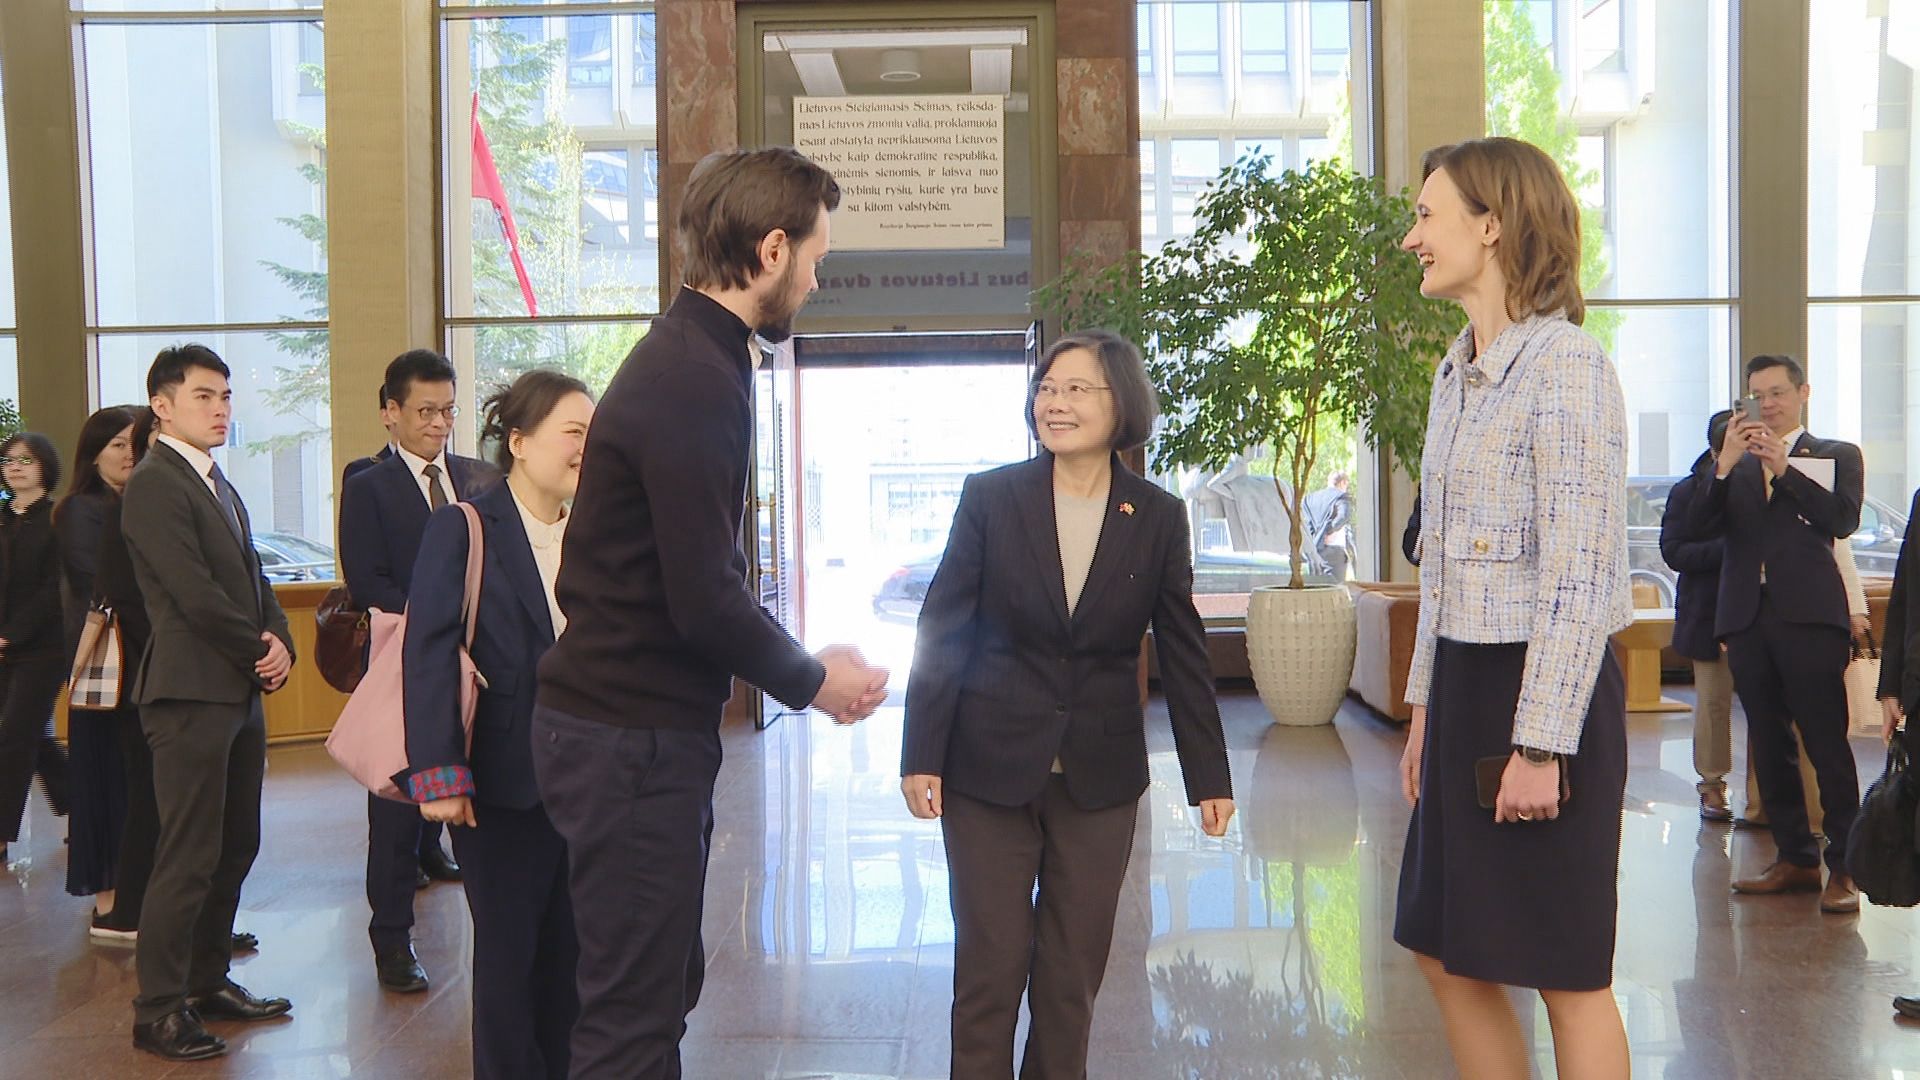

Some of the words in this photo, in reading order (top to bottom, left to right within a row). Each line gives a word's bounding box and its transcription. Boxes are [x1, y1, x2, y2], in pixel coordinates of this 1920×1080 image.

[799, 102, 842, 113] Lietuvos
[955, 134, 998, 145] Lietuvos
[847, 151, 870, 163] kaip
[928, 167, 936, 177] ir
[979, 168, 998, 177] nuo
[919, 184, 945, 195] kurie
[950, 186, 967, 196] yra
[847, 202, 860, 212] su
[864, 201, 893, 212] kitom
